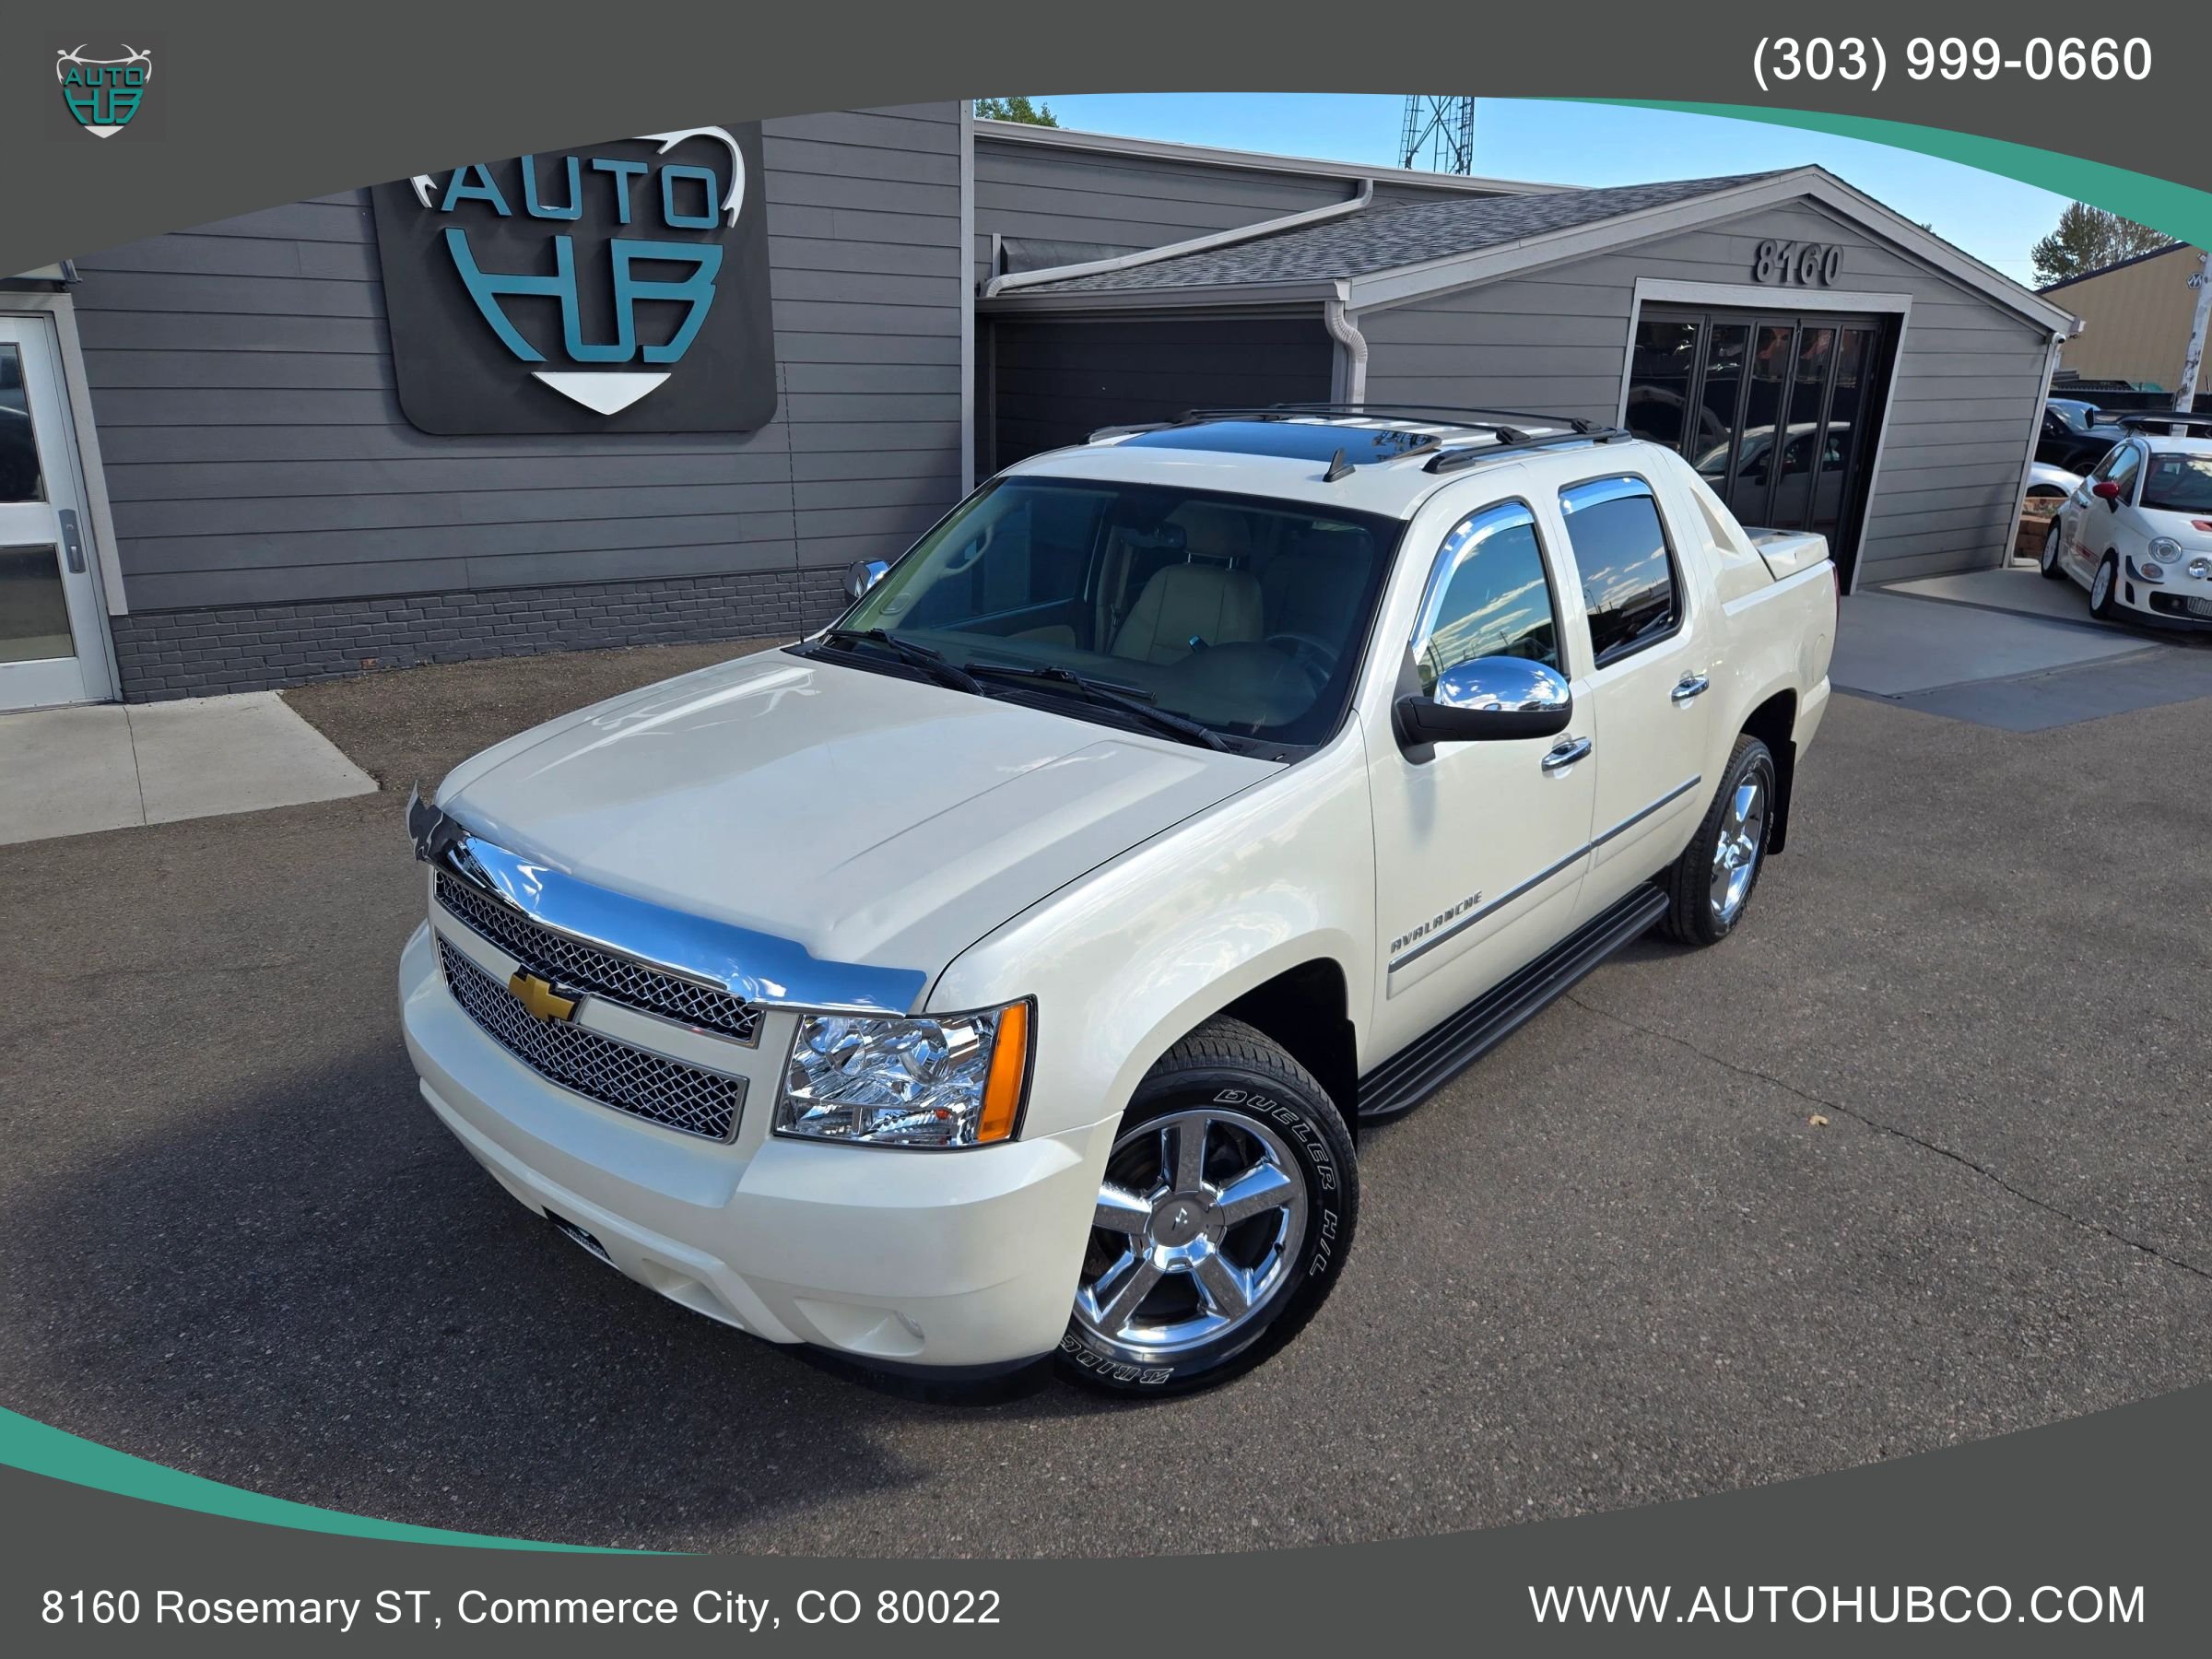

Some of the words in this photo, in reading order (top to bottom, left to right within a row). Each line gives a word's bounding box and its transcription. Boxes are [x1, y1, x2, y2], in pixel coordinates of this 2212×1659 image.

[441, 154, 720, 229] AUTO
[444, 227, 724, 363] HUB
[1755, 239, 1844, 287] 8160
[1390, 890, 1483, 954] AVALANCHE
[1213, 1088, 1336, 1191] DUELER
[1309, 1208, 1338, 1277] H/L
